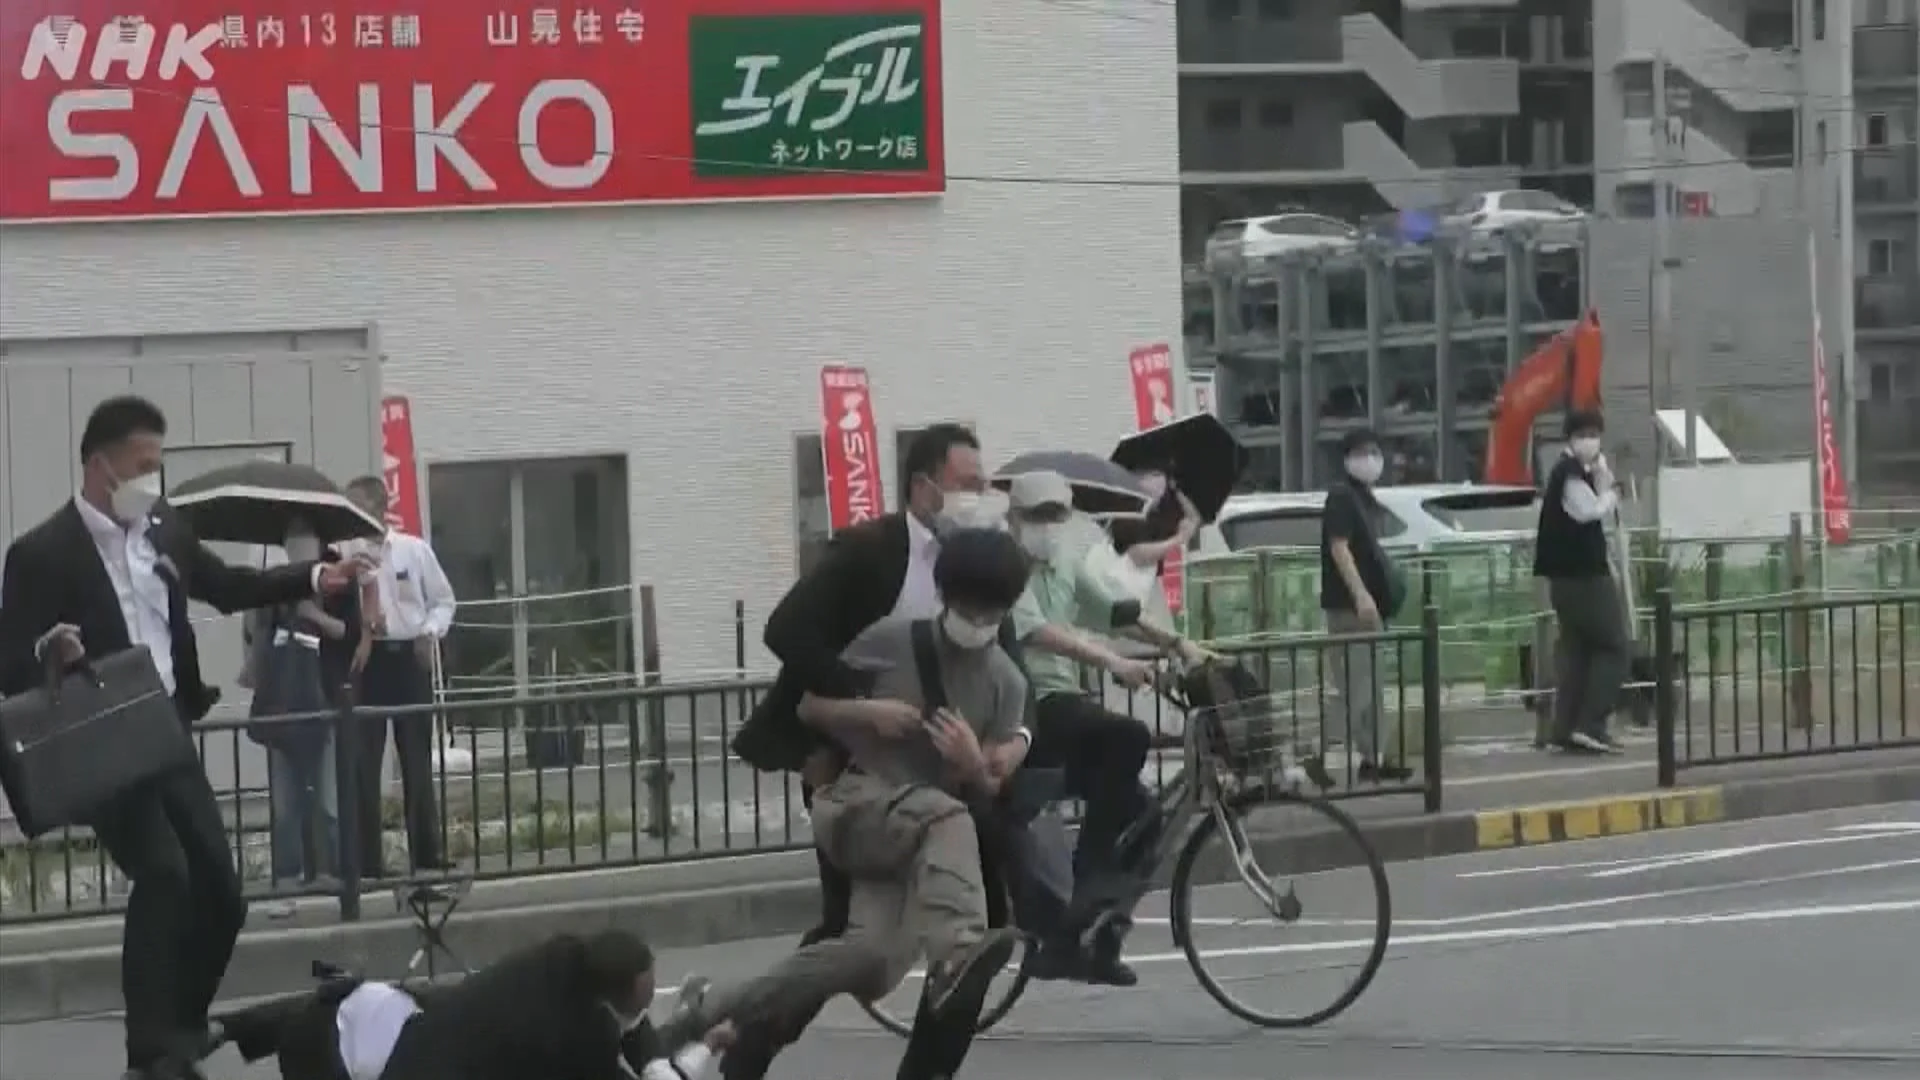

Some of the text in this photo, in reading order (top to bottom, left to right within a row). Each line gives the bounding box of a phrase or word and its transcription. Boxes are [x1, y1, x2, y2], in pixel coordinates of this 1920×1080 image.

[696, 24, 921, 135] エイブル
[47, 79, 616, 202] SANKO
[769, 135, 919, 168] ネットワーク店
[841, 430, 874, 528] SANK
